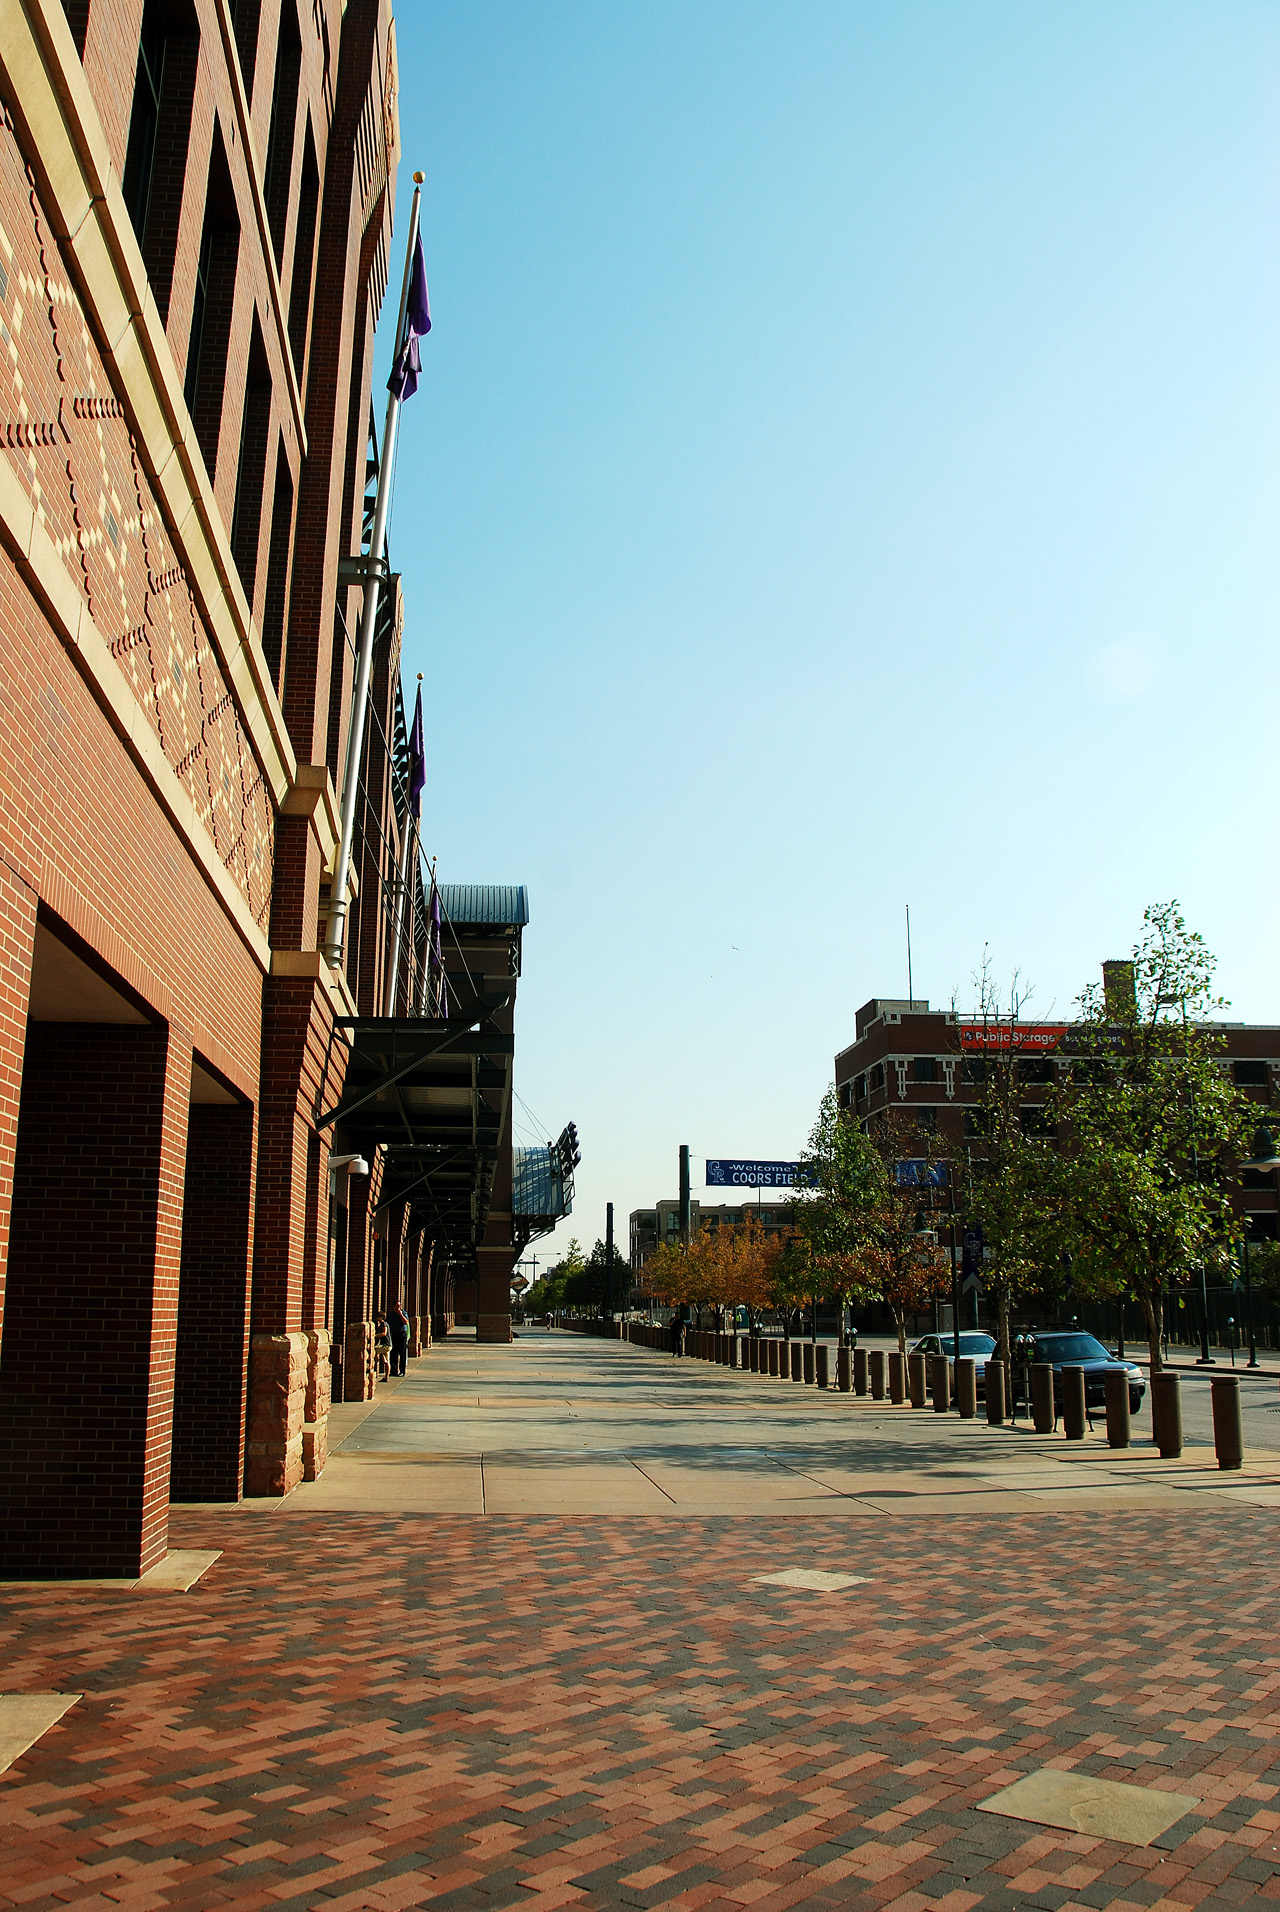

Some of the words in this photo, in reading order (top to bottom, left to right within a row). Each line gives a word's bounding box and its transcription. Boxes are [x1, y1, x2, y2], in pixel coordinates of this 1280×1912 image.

[975, 1031, 1010, 1042] Public
[1012, 1031, 1055, 1045] Storage
[732, 1163, 791, 1172] Welcome
[732, 1172, 771, 1184] COORS
[775, 1173, 808, 1185] FIED
